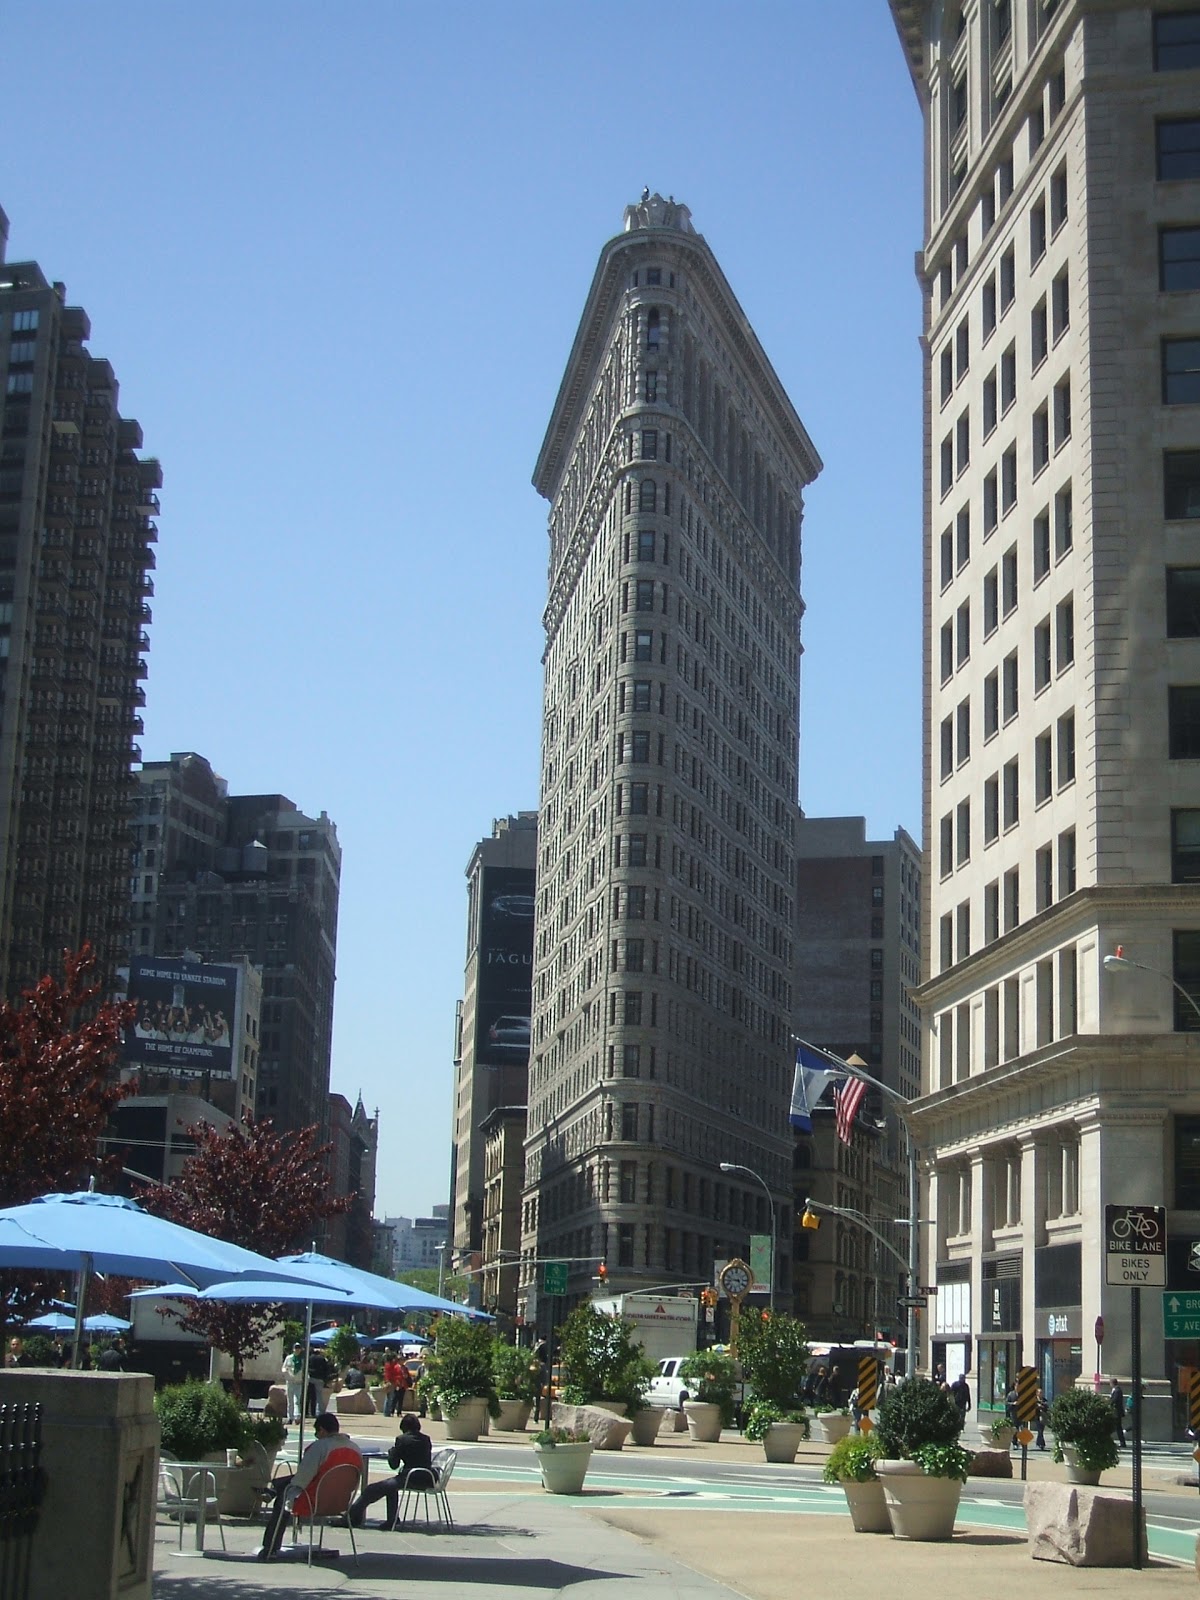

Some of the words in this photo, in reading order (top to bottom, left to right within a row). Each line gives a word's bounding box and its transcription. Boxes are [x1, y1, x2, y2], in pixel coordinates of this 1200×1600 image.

[140, 968, 155, 977] COME
[156, 970, 172, 979] HOME
[173, 972, 180, 980] TO
[181, 973, 201, 983] YANKEE
[145, 1042, 156, 1051] THE
[157, 1044, 173, 1053] HOME
[174, 1045, 181, 1054] OF
[1109, 1240, 1131, 1251] BIKE
[1135, 1241, 1162, 1252] LANE
[1121, 1258, 1150, 1268] BIKES
[1122, 1270, 1149, 1281] ONLY
[1055, 1314, 1068, 1332] at&t
[1173, 1321, 1179, 1331] 5
[1183, 1321, 1200, 1331] AVE
